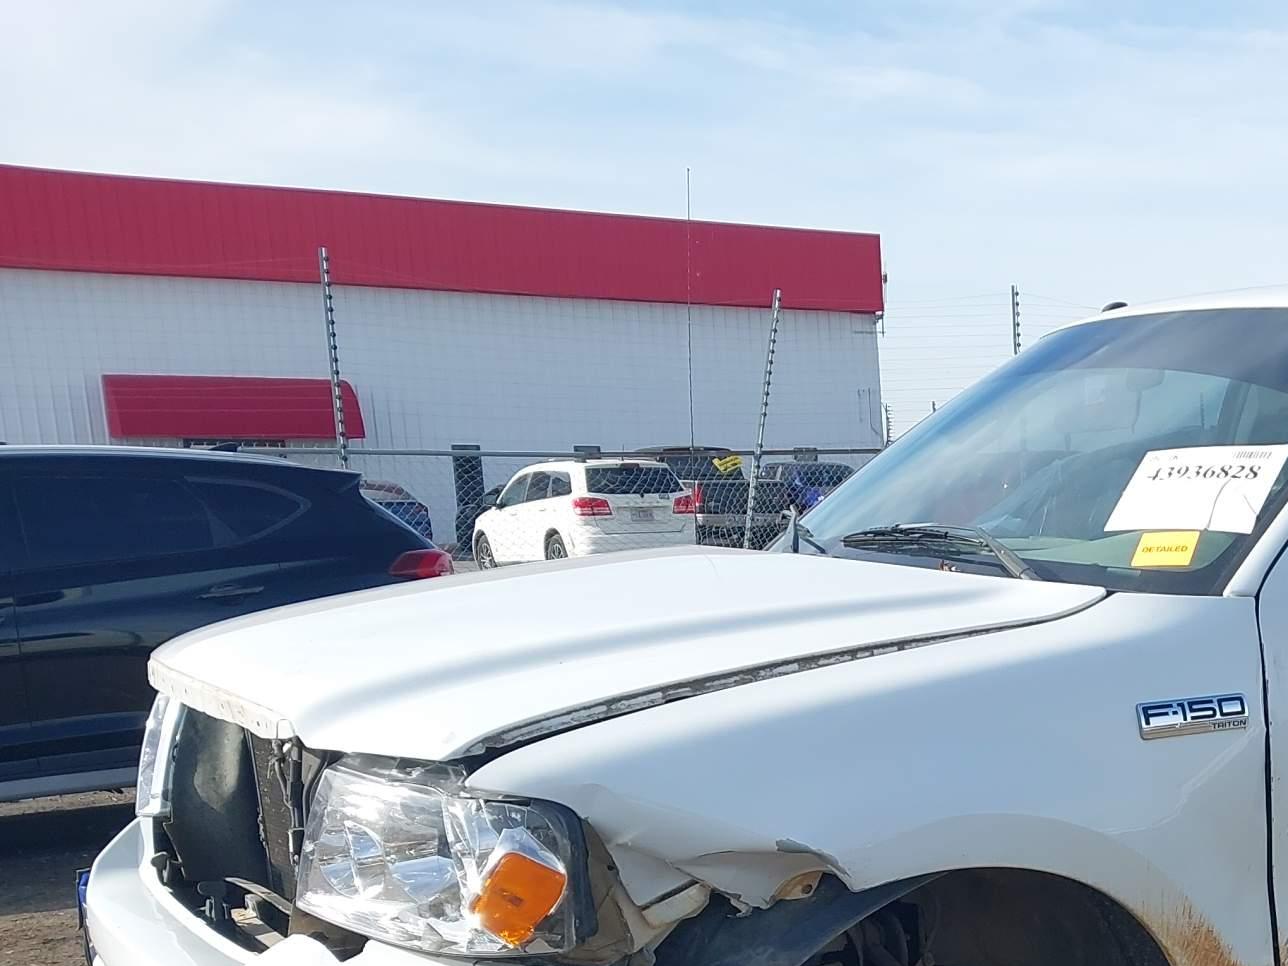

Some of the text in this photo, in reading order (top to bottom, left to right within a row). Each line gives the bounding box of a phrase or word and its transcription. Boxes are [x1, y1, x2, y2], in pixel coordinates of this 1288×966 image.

[1147, 464, 1262, 481] 43936828
[1141, 544, 1189, 553] DETAILED
[1141, 695, 1246, 726] F-150
[1212, 718, 1247, 730] TRITON
